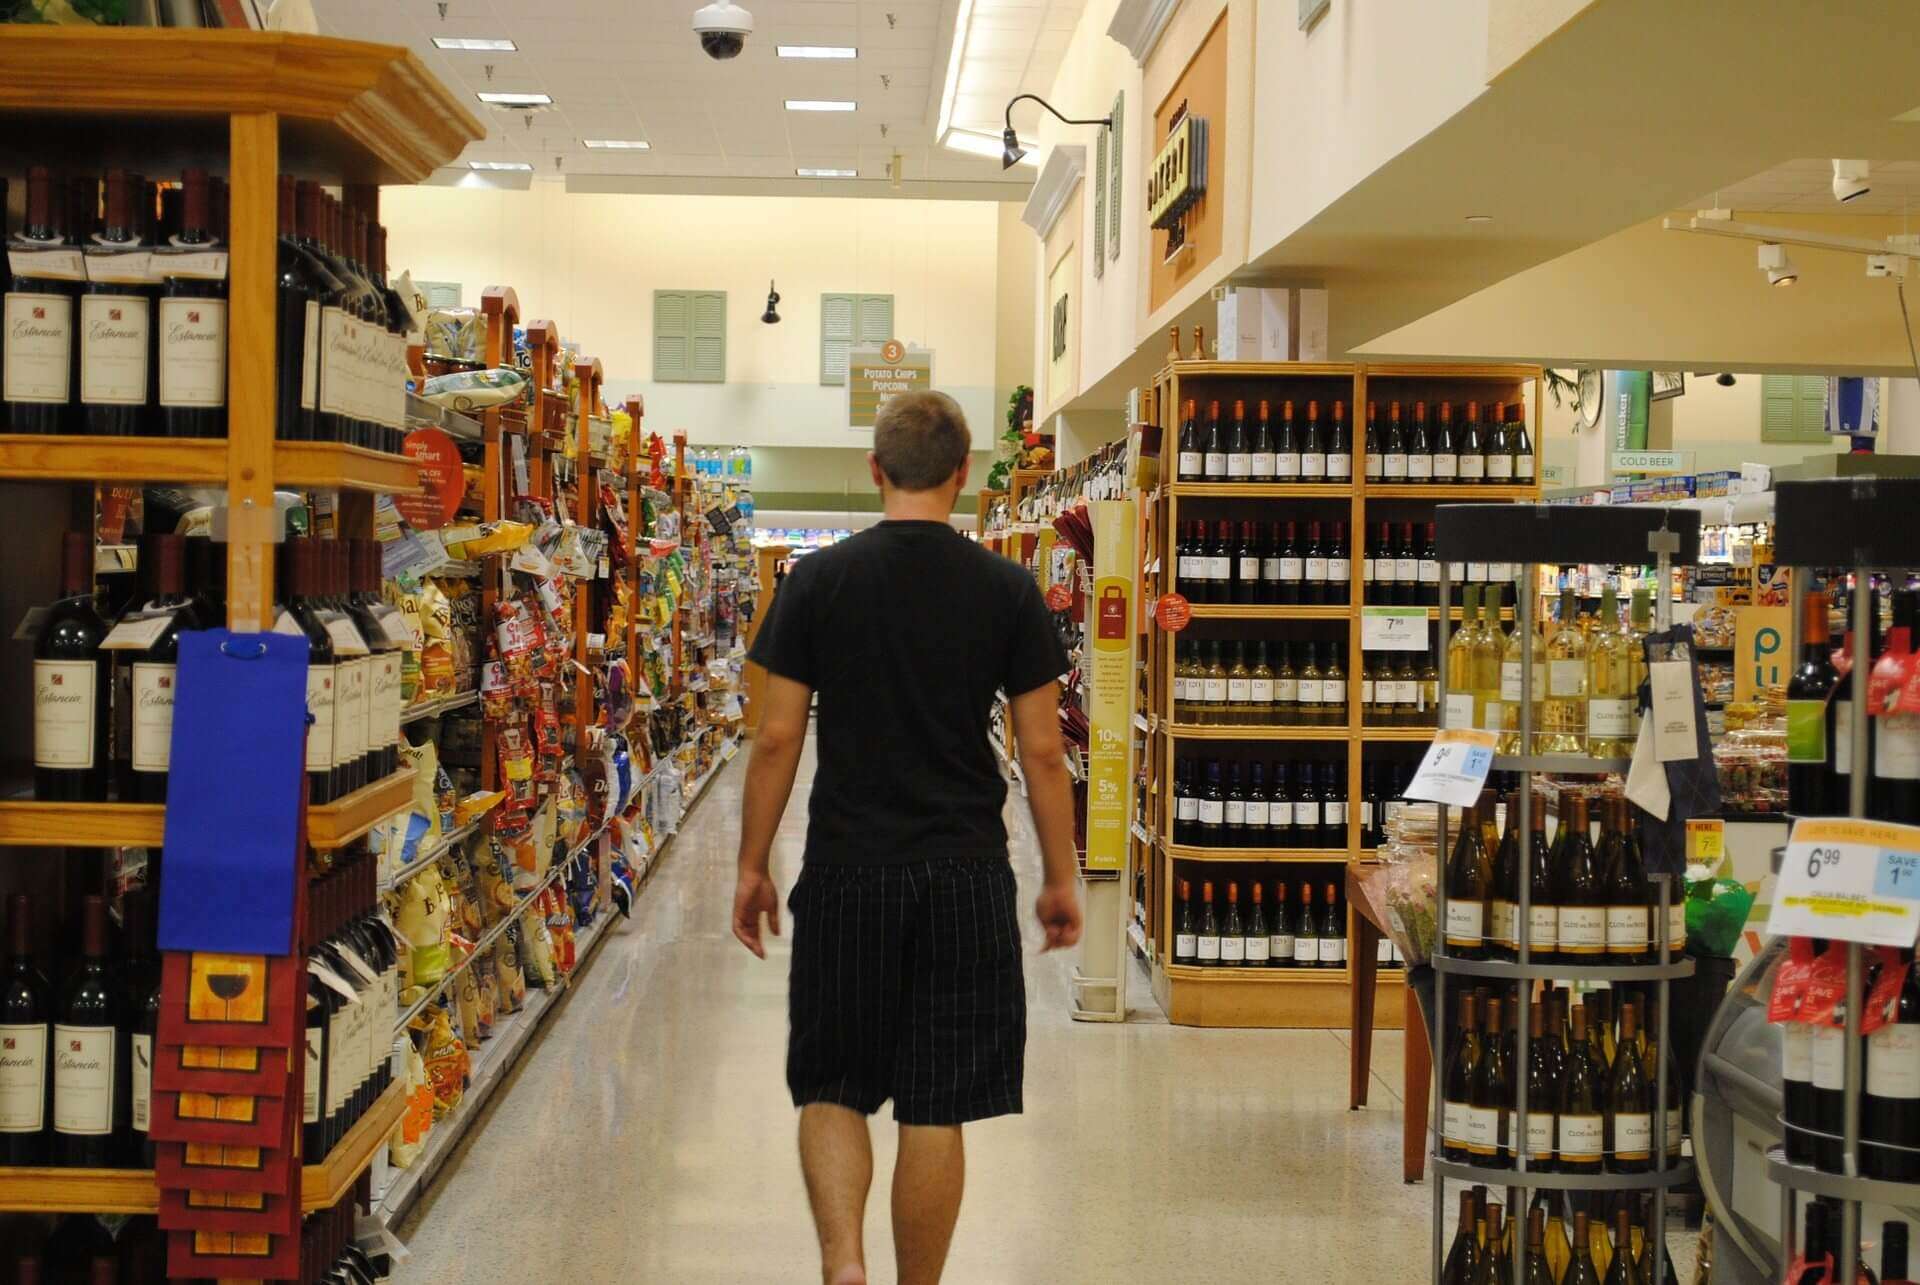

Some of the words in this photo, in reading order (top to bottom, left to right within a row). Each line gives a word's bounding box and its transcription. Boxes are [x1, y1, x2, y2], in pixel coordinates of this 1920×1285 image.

[888, 345, 897, 358] 3
[1617, 393, 1628, 451] eineken
[1620, 457, 1647, 466] COLD
[1649, 457, 1673, 466] BEER
[1544, 470, 1556, 478] ER
[138, 688, 175, 709] Estan
[1096, 728, 1124, 743] 10%
[1098, 779, 1119, 793] 5%
[1888, 855, 1920, 867] SAVE
